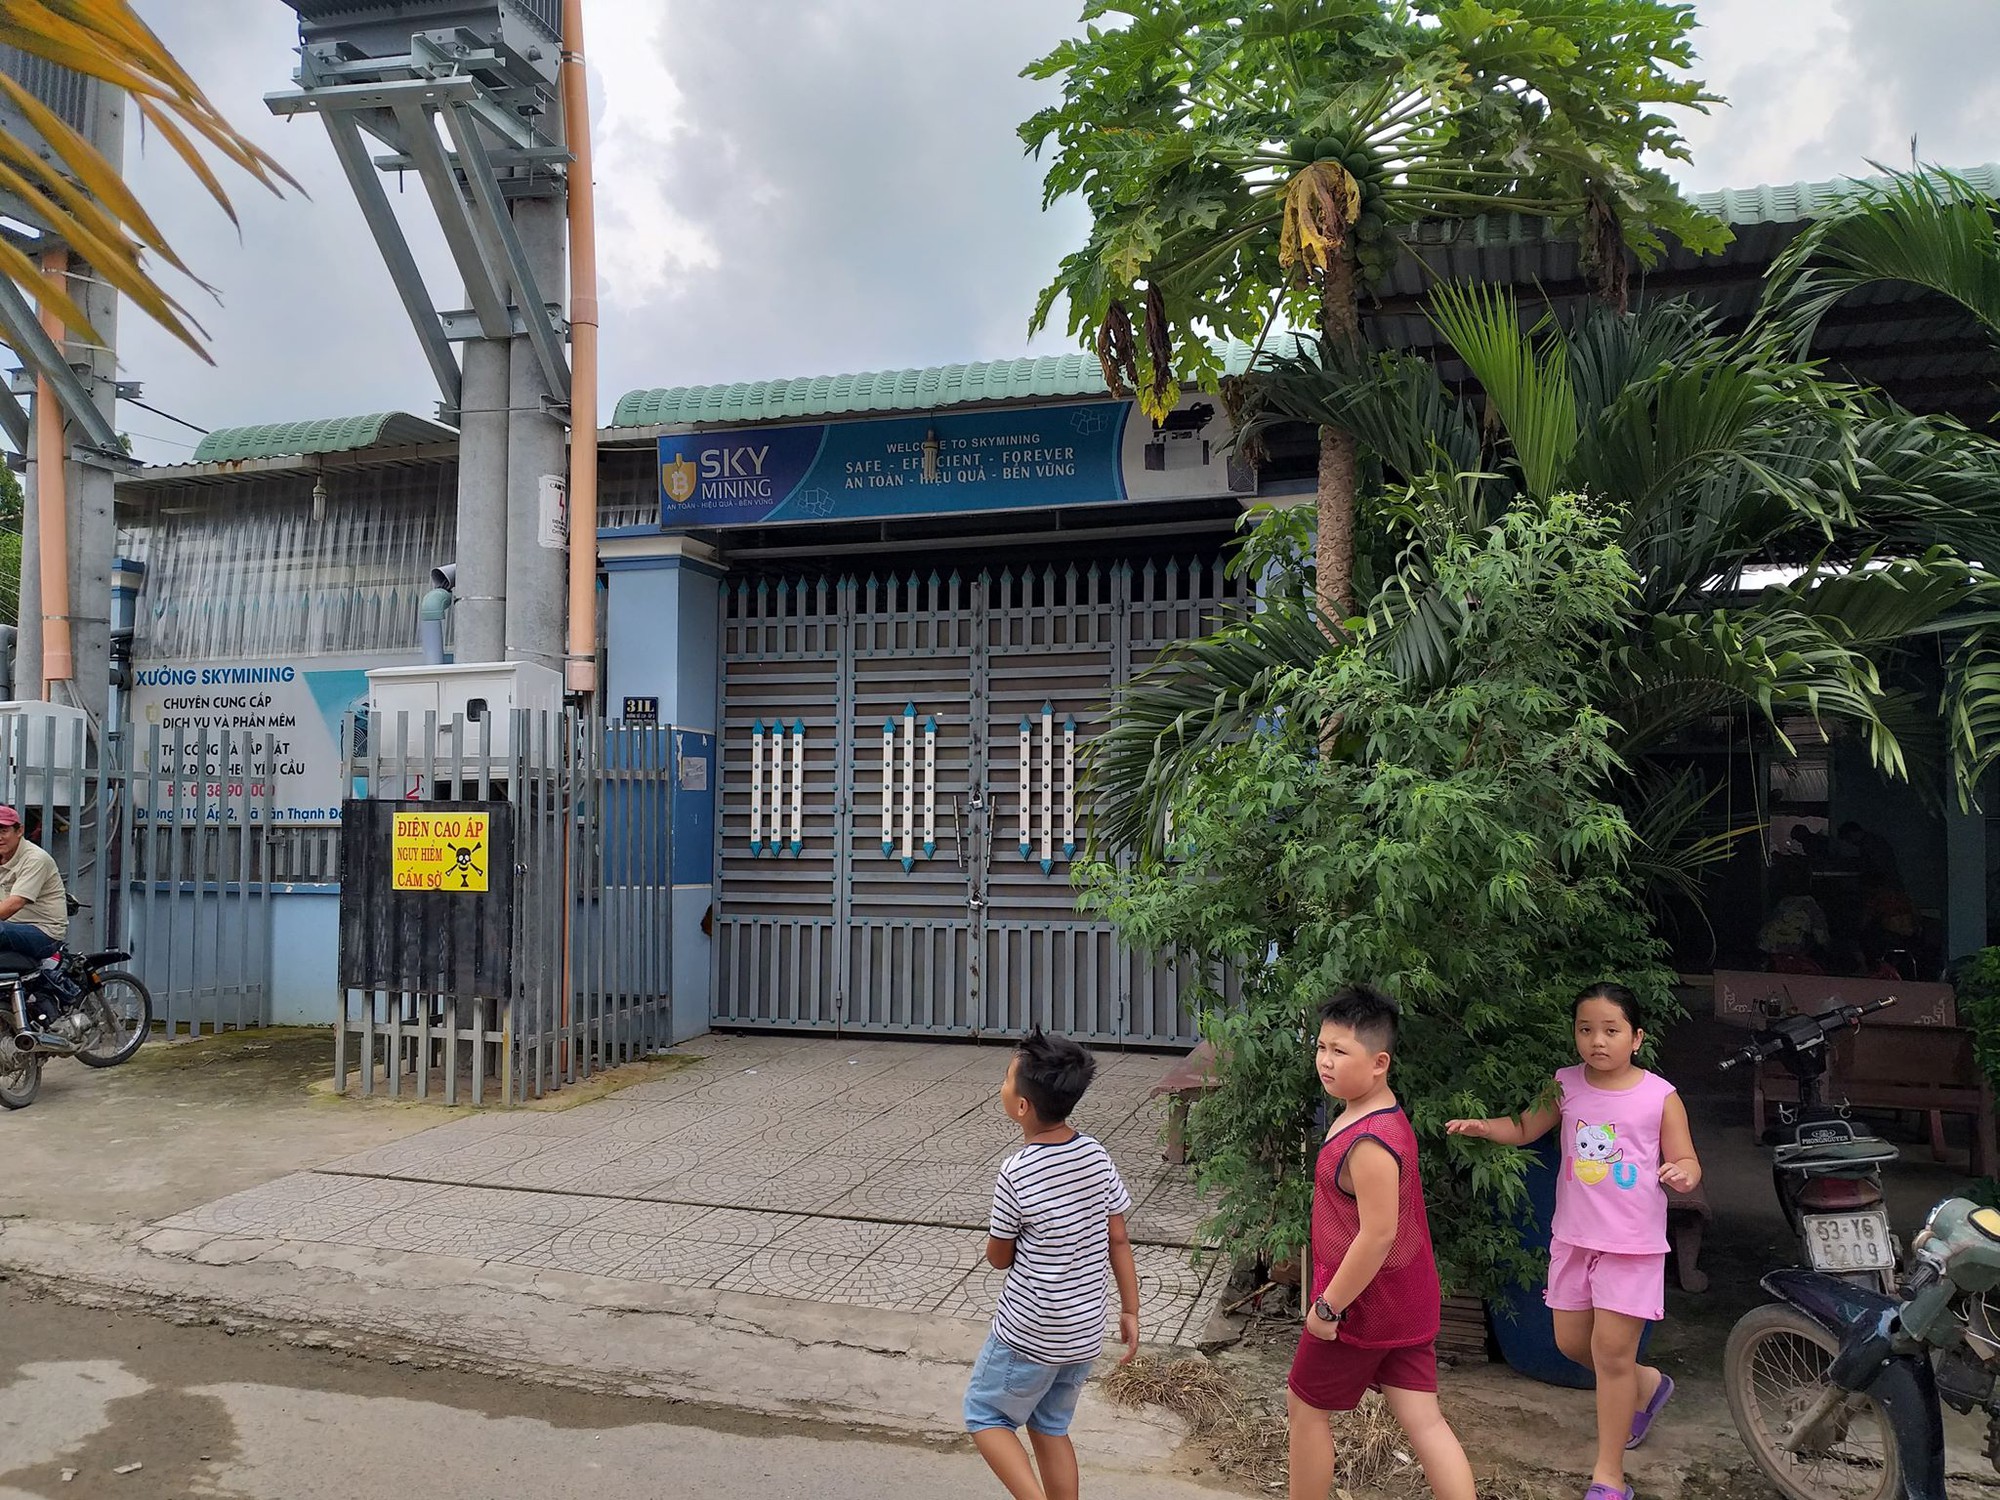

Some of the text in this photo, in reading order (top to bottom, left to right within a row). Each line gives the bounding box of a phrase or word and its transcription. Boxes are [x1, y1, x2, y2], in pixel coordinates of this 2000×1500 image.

[887, 434, 1040, 454] WELCOE TO SKYMINING
[700, 445, 769, 478] SKY
[845, 460, 882, 474] SAFE
[1002, 447, 1074, 464] FOREVER
[845, 476, 863, 489] AN
[868, 471, 904, 488] TOÀN
[957, 465, 986, 483] QUẢ
[1036, 461, 1075, 477] VỮNG
[702, 479, 771, 500] MINING
[135, 665, 295, 686] XƯỞNG SKYMINING
[163, 691, 272, 710] CHUYÊN CUNG CẤP
[163, 717, 190, 731] DỊCH
[213, 714, 229, 728] VÀ
[232, 712, 265, 727] PHẦN
[229, 740, 238, 755] À
[272, 740, 290, 757] ẶT
[189, 764, 215, 775] ĐO
[287, 807, 325, 823] Thạnh
[397, 817, 484, 841] ĐIỆN CAO ÁP
[397, 847, 419, 861] NGUY
[397, 866, 442, 887] CẤM SỜ
[1613, 1162, 1638, 1189] U
